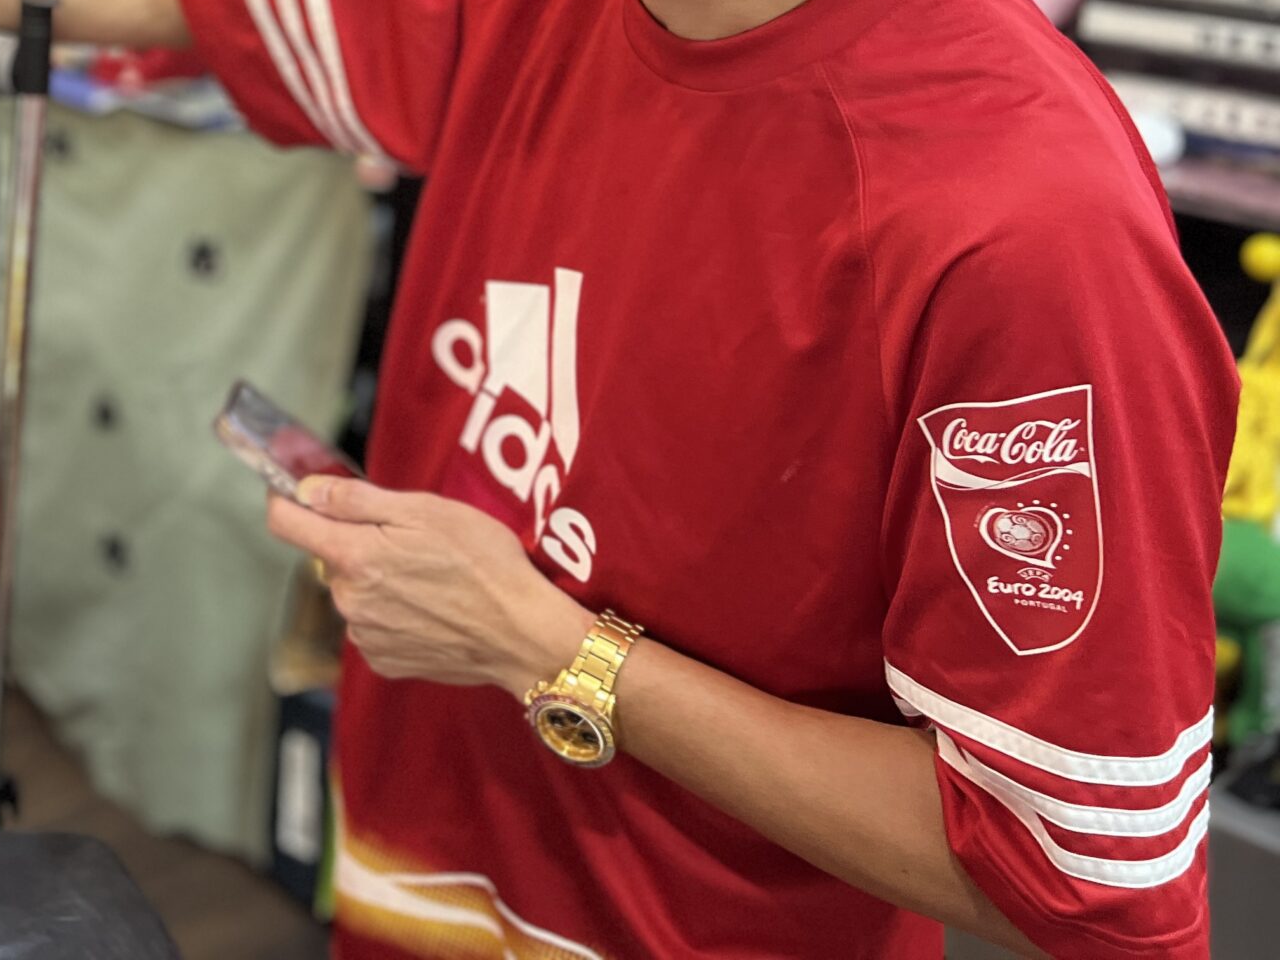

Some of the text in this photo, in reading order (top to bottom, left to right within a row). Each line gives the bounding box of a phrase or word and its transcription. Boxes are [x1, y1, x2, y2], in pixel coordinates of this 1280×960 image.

[942, 418, 1082, 464] Coca-Cola
[987, 576, 1084, 610] Euro 2004
[1014, 598, 1068, 613] PORTUGAL
